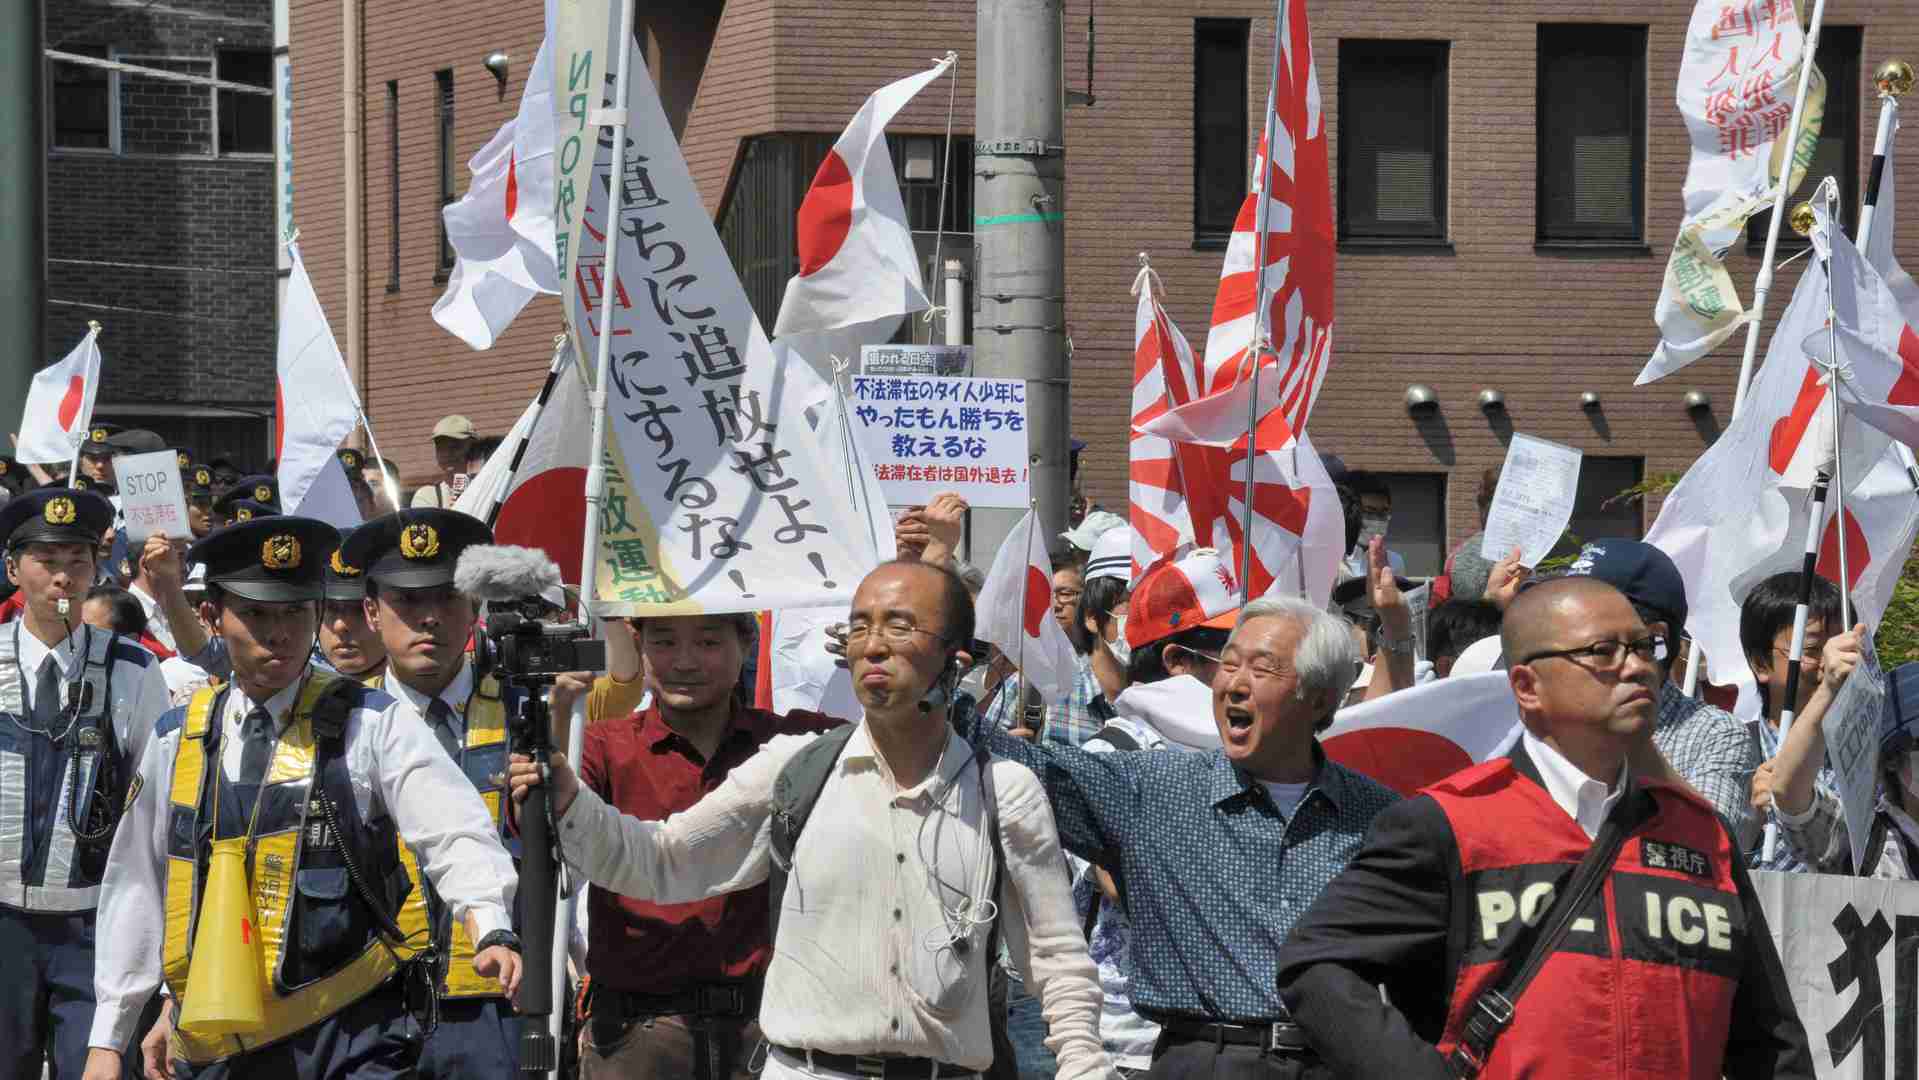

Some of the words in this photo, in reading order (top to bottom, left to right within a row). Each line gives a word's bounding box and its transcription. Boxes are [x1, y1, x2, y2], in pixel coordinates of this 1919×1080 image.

[595, 99, 837, 589] 直ちに追放せよ！
[854, 378, 1025, 404] 不法滞在のタイ人少年に
[856, 405, 1025, 431] やったもん勝ちを
[891, 433, 987, 458] 教えるな
[127, 471, 168, 496] STOP
[872, 464, 1028, 483] 法滞在者は国外退去！
[1646, 842, 1705, 874] 警視庁
